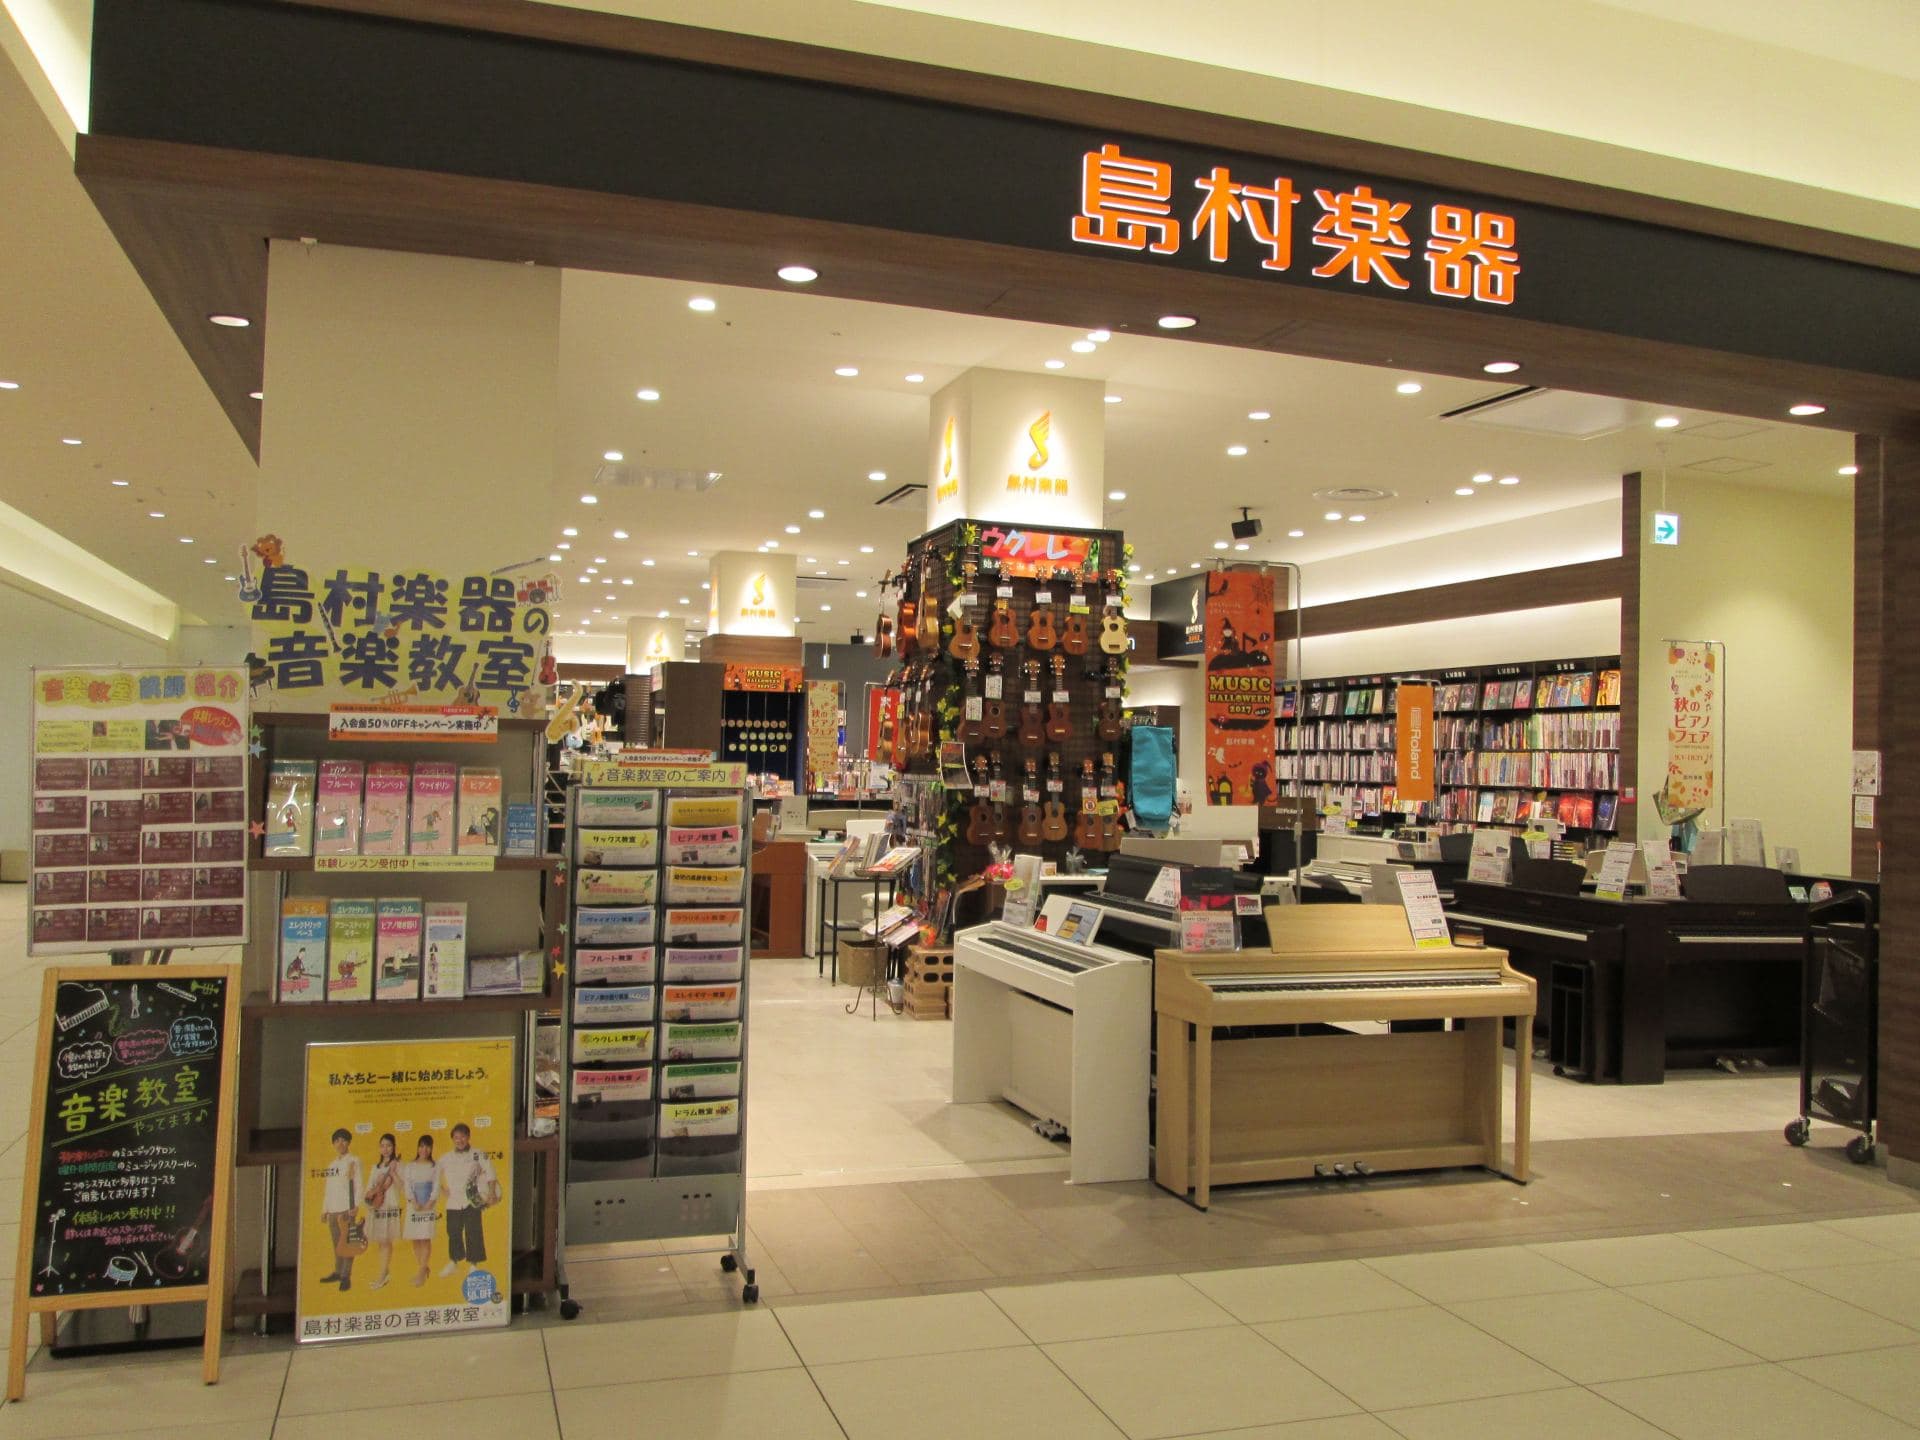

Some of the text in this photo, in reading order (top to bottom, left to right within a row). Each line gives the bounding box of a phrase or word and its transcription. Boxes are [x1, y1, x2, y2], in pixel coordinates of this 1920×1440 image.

[1071, 144, 1520, 305] 島村楽器
[981, 527, 1069, 559] ウクレレ
[251, 563, 549, 636] 島村楽器の
[268, 630, 534, 692] 音楽教室
[747, 670, 781, 678] MUSIC
[1209, 675, 1271, 692] MUSIC
[1209, 694, 1270, 703] HALLOWEEN
[1674, 697, 1700, 713] 秋の
[1229, 705, 1253, 714] 2017
[1674, 715, 1710, 729] ピアノ
[1675, 730, 1710, 744] フェア
[1410, 730, 1422, 780] Roland
[607, 768, 726, 783] 音楽教室のご案内
[327, 780, 356, 789] フルート
[371, 781, 405, 790] トランペット
[470, 781, 492, 790] ピアノ
[593, 836, 636, 844] サックス教室
[678, 833, 717, 843] ピアノ教室
[589, 954, 633, 962] フルート教室
[592, 1035, 637, 1043] ウクレレ教室
[57, 1065, 200, 1132] 音楽教室
[675, 1107, 713, 1116] ドラム教室
[304, 1306, 481, 1336] 島村楽器の音楽教室
